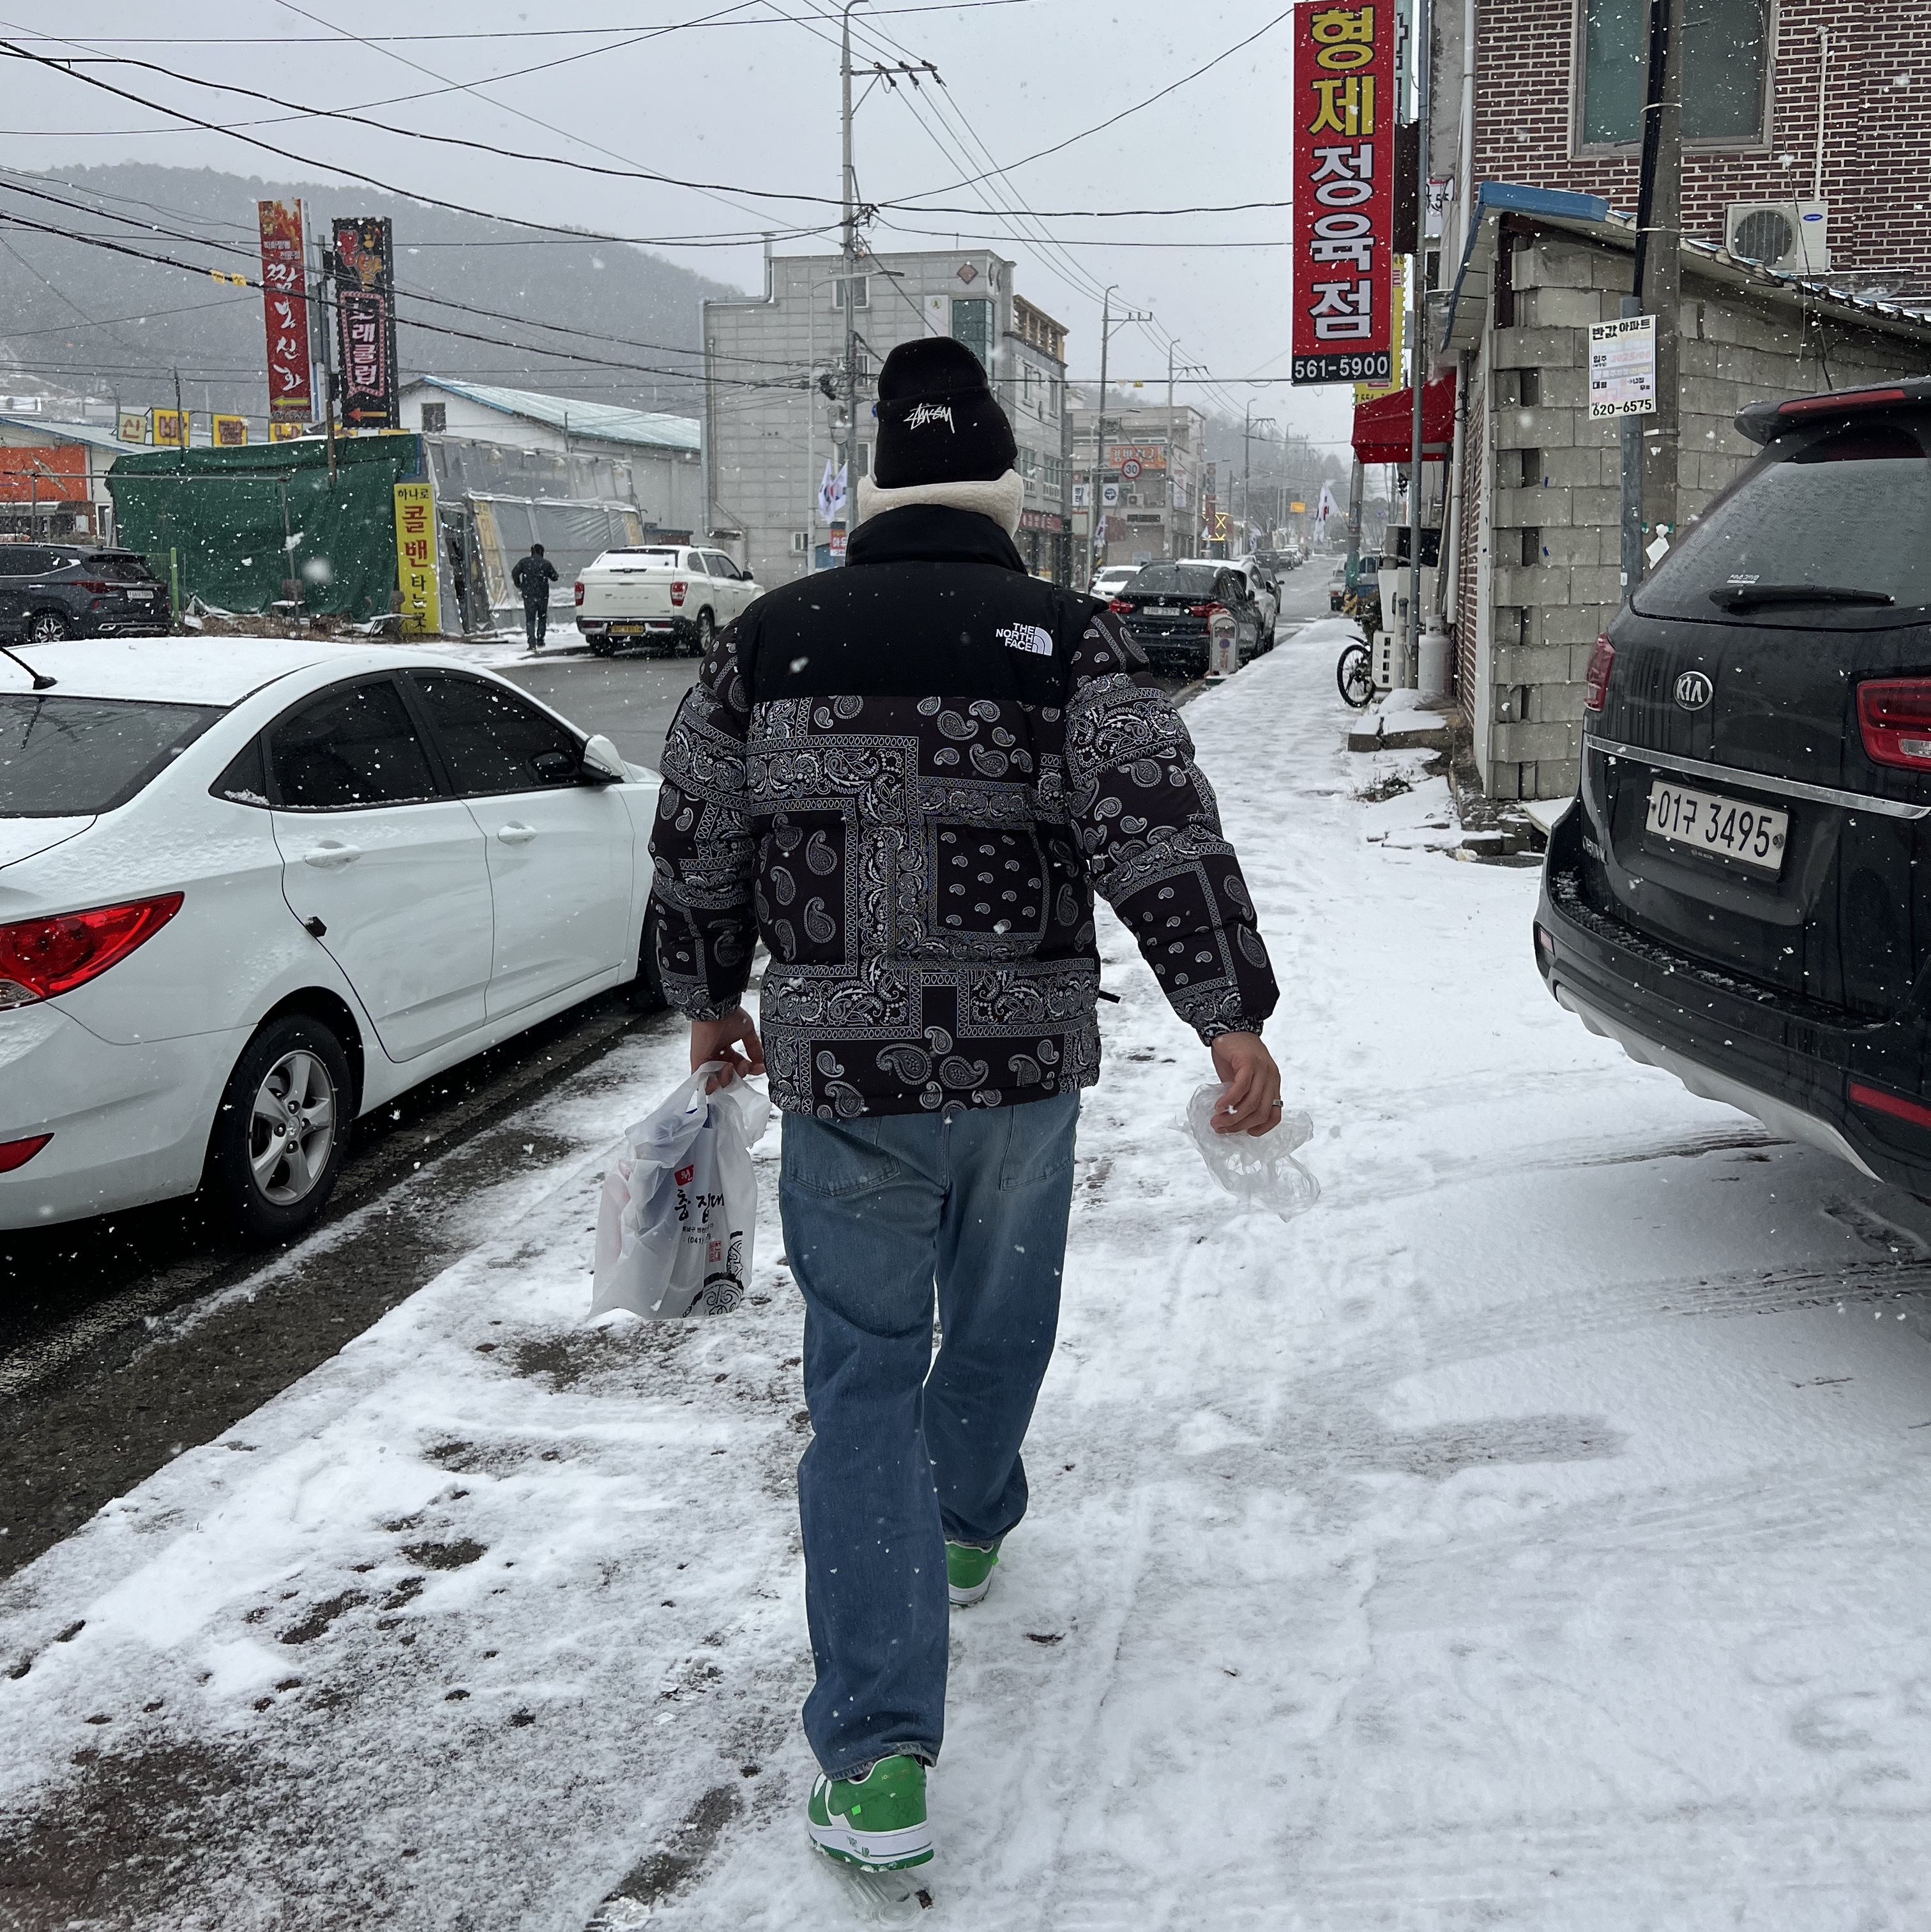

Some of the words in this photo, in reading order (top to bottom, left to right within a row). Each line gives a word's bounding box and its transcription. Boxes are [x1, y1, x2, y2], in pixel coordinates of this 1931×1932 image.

[1592, 325, 1617, 340] 반값
[1619, 318, 1651, 333] 아파트
[1294, 356, 1388, 379] 561-5900
[1592, 399, 1652, 416] 620-6575
[1125, 464, 1137, 475] 30
[397, 488, 430, 501] 하나로
[401, 505, 428, 568] 콜밴
[996, 628, 1033, 643] NORTH
[1013, 622, 1035, 635] THE
[1004, 637, 1033, 652] FACE
[1676, 676, 1703, 703] KIA
[1657, 790, 1698, 835] 01구
[1705, 803, 1773, 858] 3495
